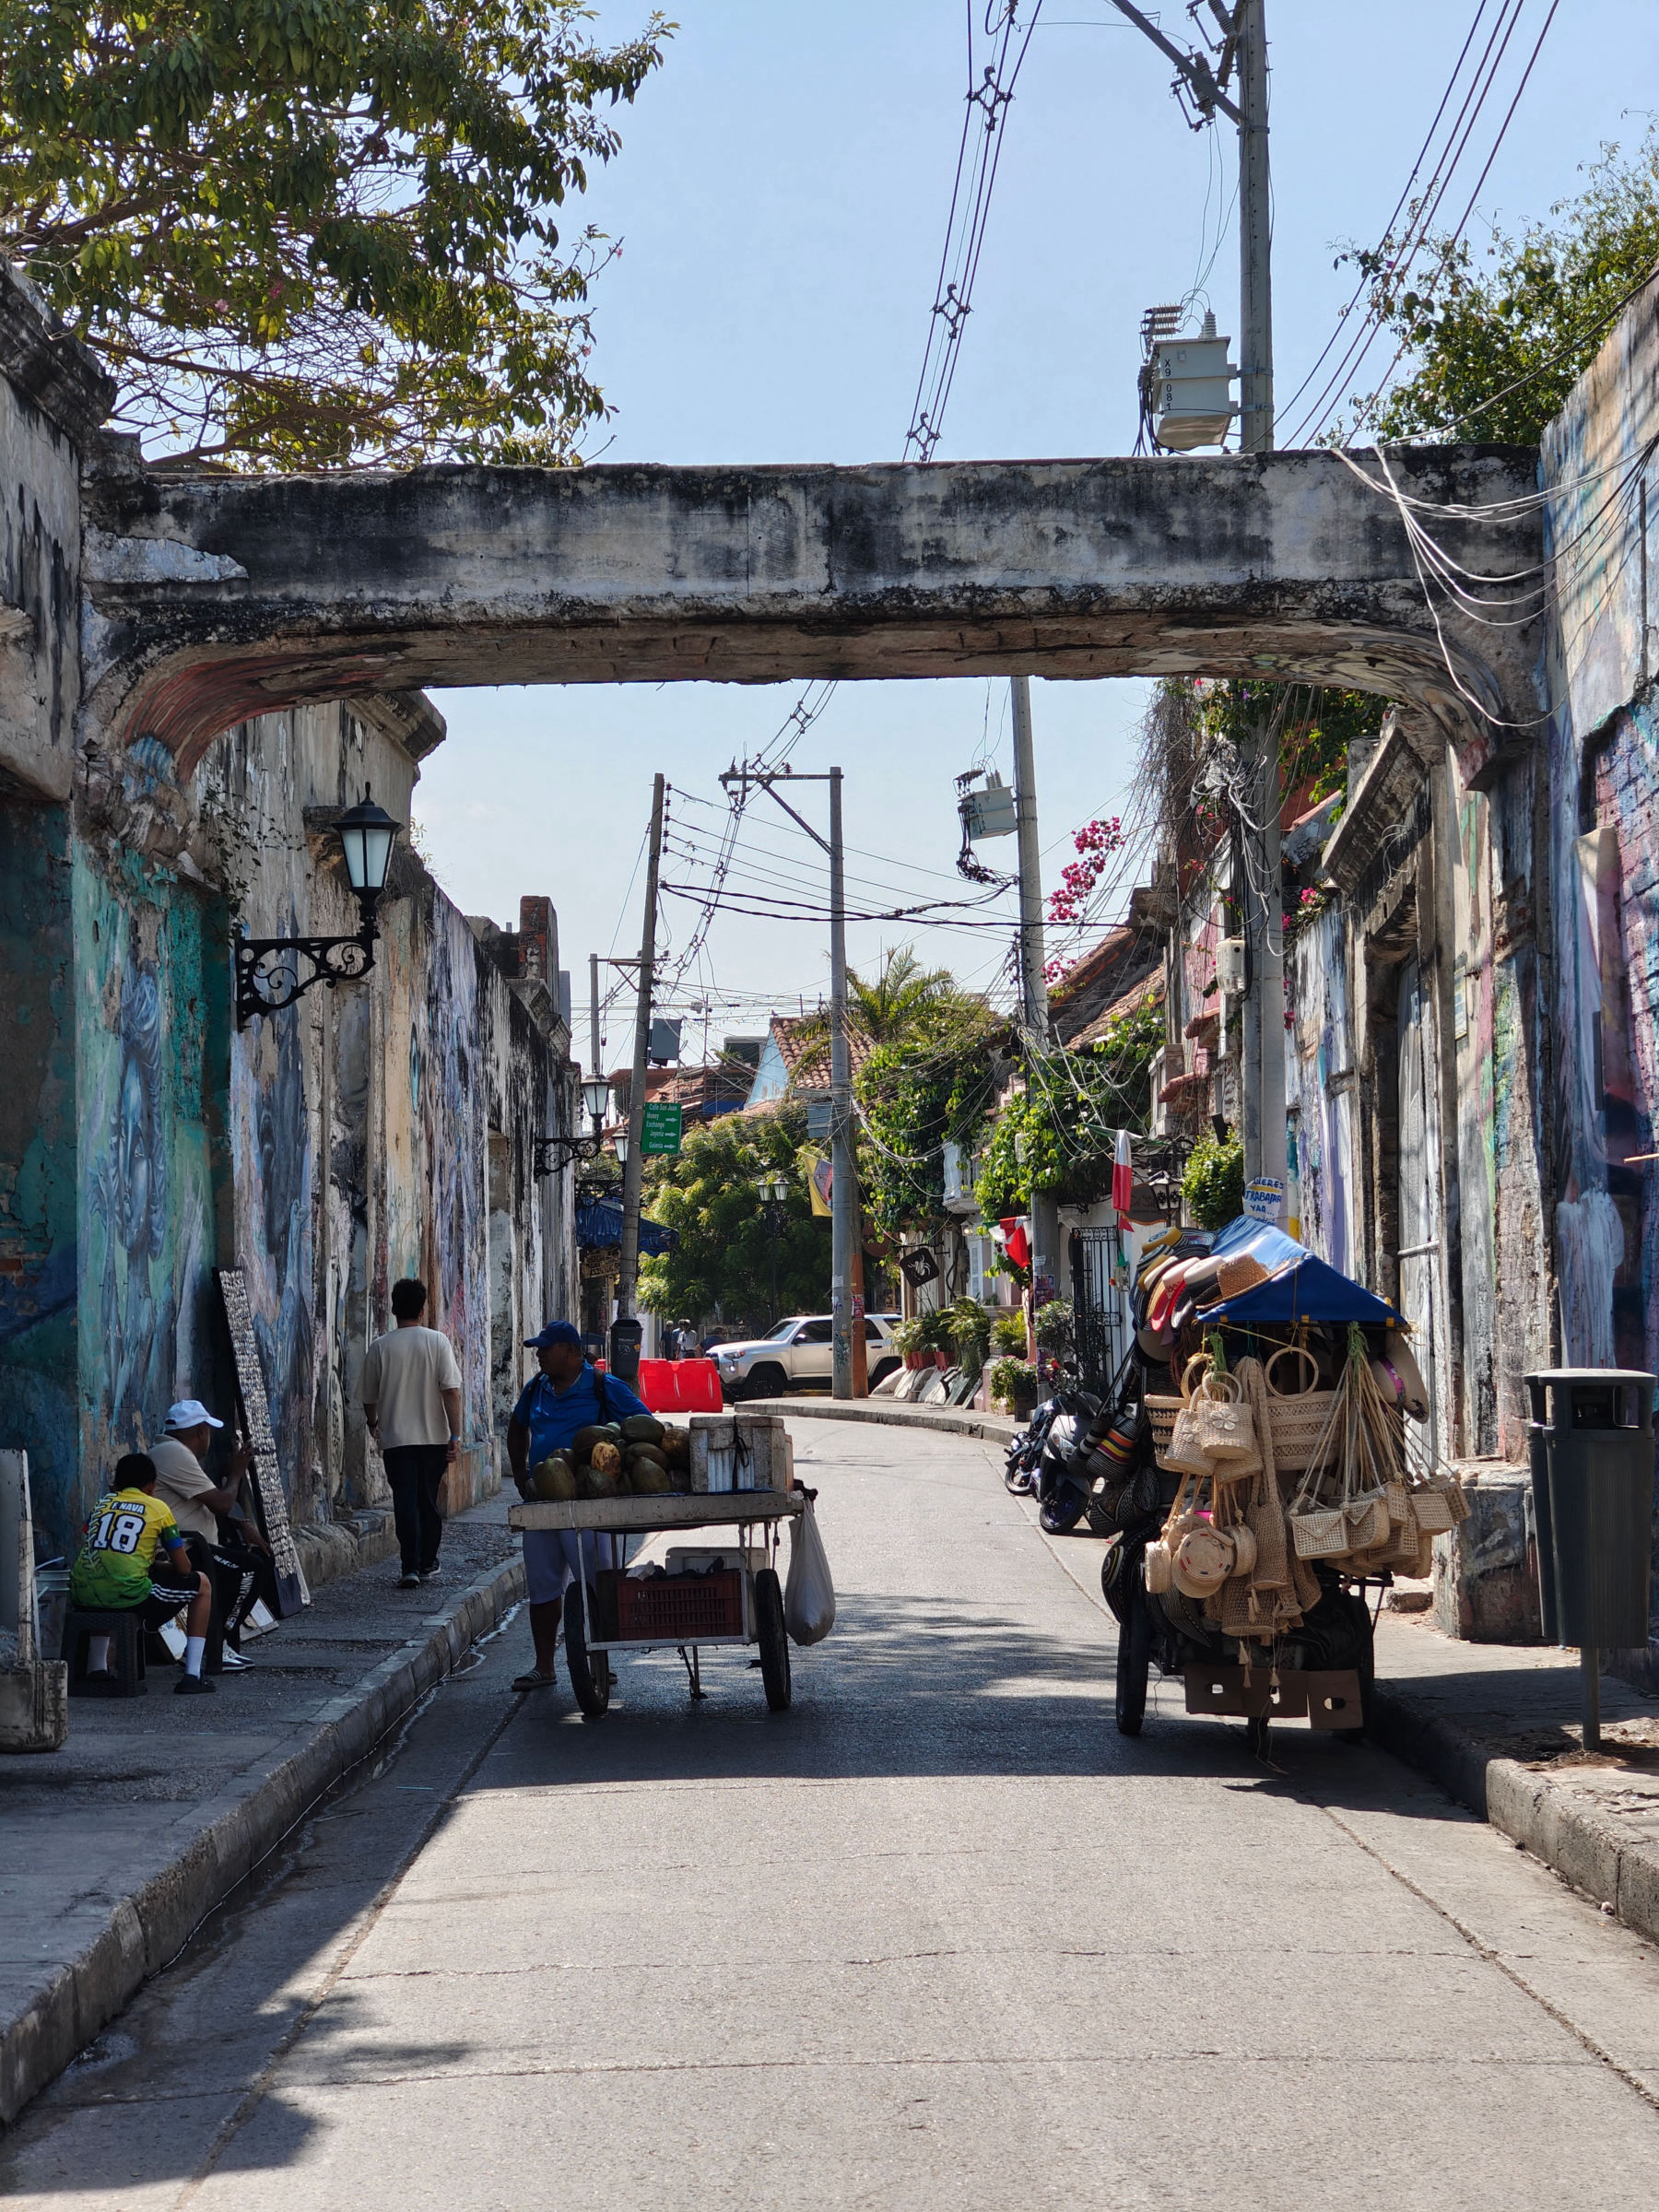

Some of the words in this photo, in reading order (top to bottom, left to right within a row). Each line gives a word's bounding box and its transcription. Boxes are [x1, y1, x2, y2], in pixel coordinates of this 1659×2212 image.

[659, 1103, 667, 1112] San
[667, 1103, 677, 1112] Juan
[646, 1120, 665, 1130] Exchange
[1252, 1178, 1284, 1190] UIERES
[1244, 1190, 1283, 1205] TRABAJAR
[119, 1502, 146, 1514] NAVA
[93, 1512, 146, 1554] 18
